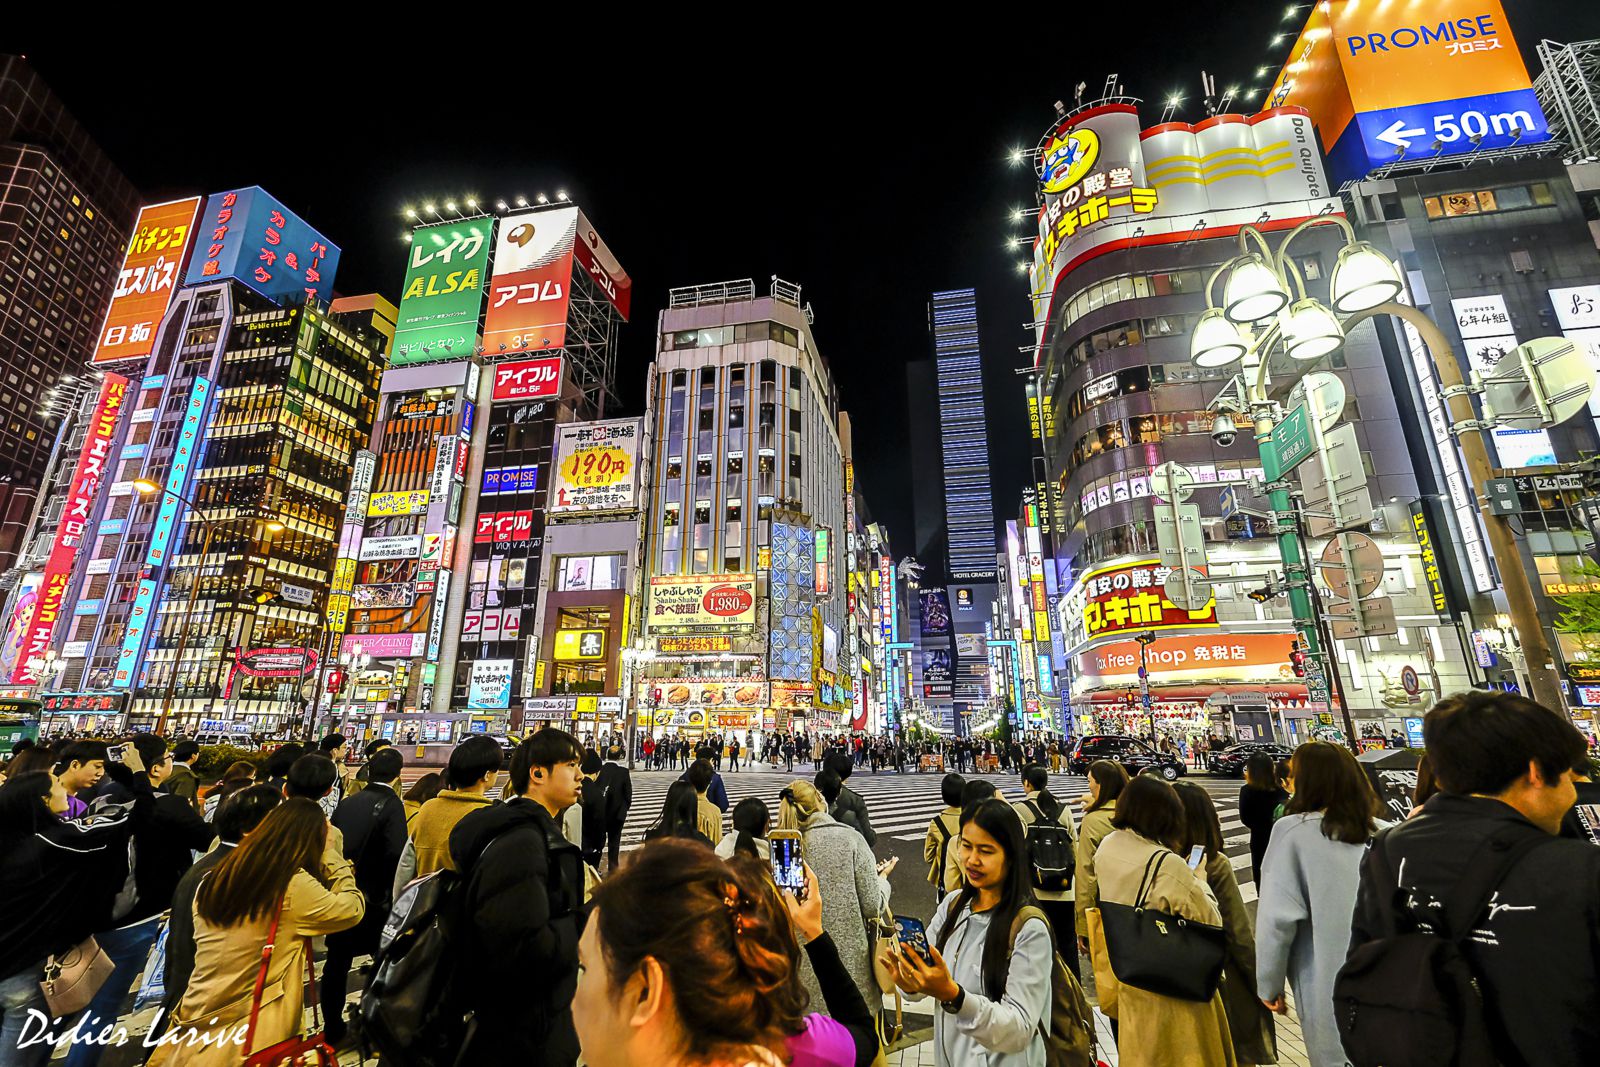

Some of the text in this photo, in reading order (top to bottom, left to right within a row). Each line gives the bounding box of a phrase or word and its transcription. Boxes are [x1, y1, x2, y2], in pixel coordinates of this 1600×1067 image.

[1347, 14, 1497, 57] PROMISE
[1445, 37, 1503, 56] プロミス
[1433, 110, 1536, 143] 50m
[1292, 117, 1319, 198] Don Quijote
[128, 225, 188, 255] パチンコ
[254, 210, 286, 283] カラオケ
[412, 235, 484, 269] レイク
[114, 256, 176, 298] エスパス
[403, 268, 479, 300] ALSA
[590, 257, 616, 301] アコム
[494, 280, 563, 309] アコム
[1459, 313, 1509, 328] 6年4組
[498, 366, 557, 387] アイフル
[571, 452, 626, 476] 190円
[487, 470, 535, 484] PROMISE
[1536, 478, 1556, 488] 24
[572, 494, 626, 505] 左の路地を右へ
[478, 516, 532, 533] アイフル
[40, 573, 68, 623] パチンコ
[653, 585, 703, 597] しゃぶしゃぶ
[708, 597, 740, 612] 1,980
[464, 614, 520, 632] アコム
[580, 634, 601, 655] 集
[1194, 645, 1247, 662] 免税店
[1108, 653, 1135, 669] Free
[1139, 647, 1187, 666] Shop
